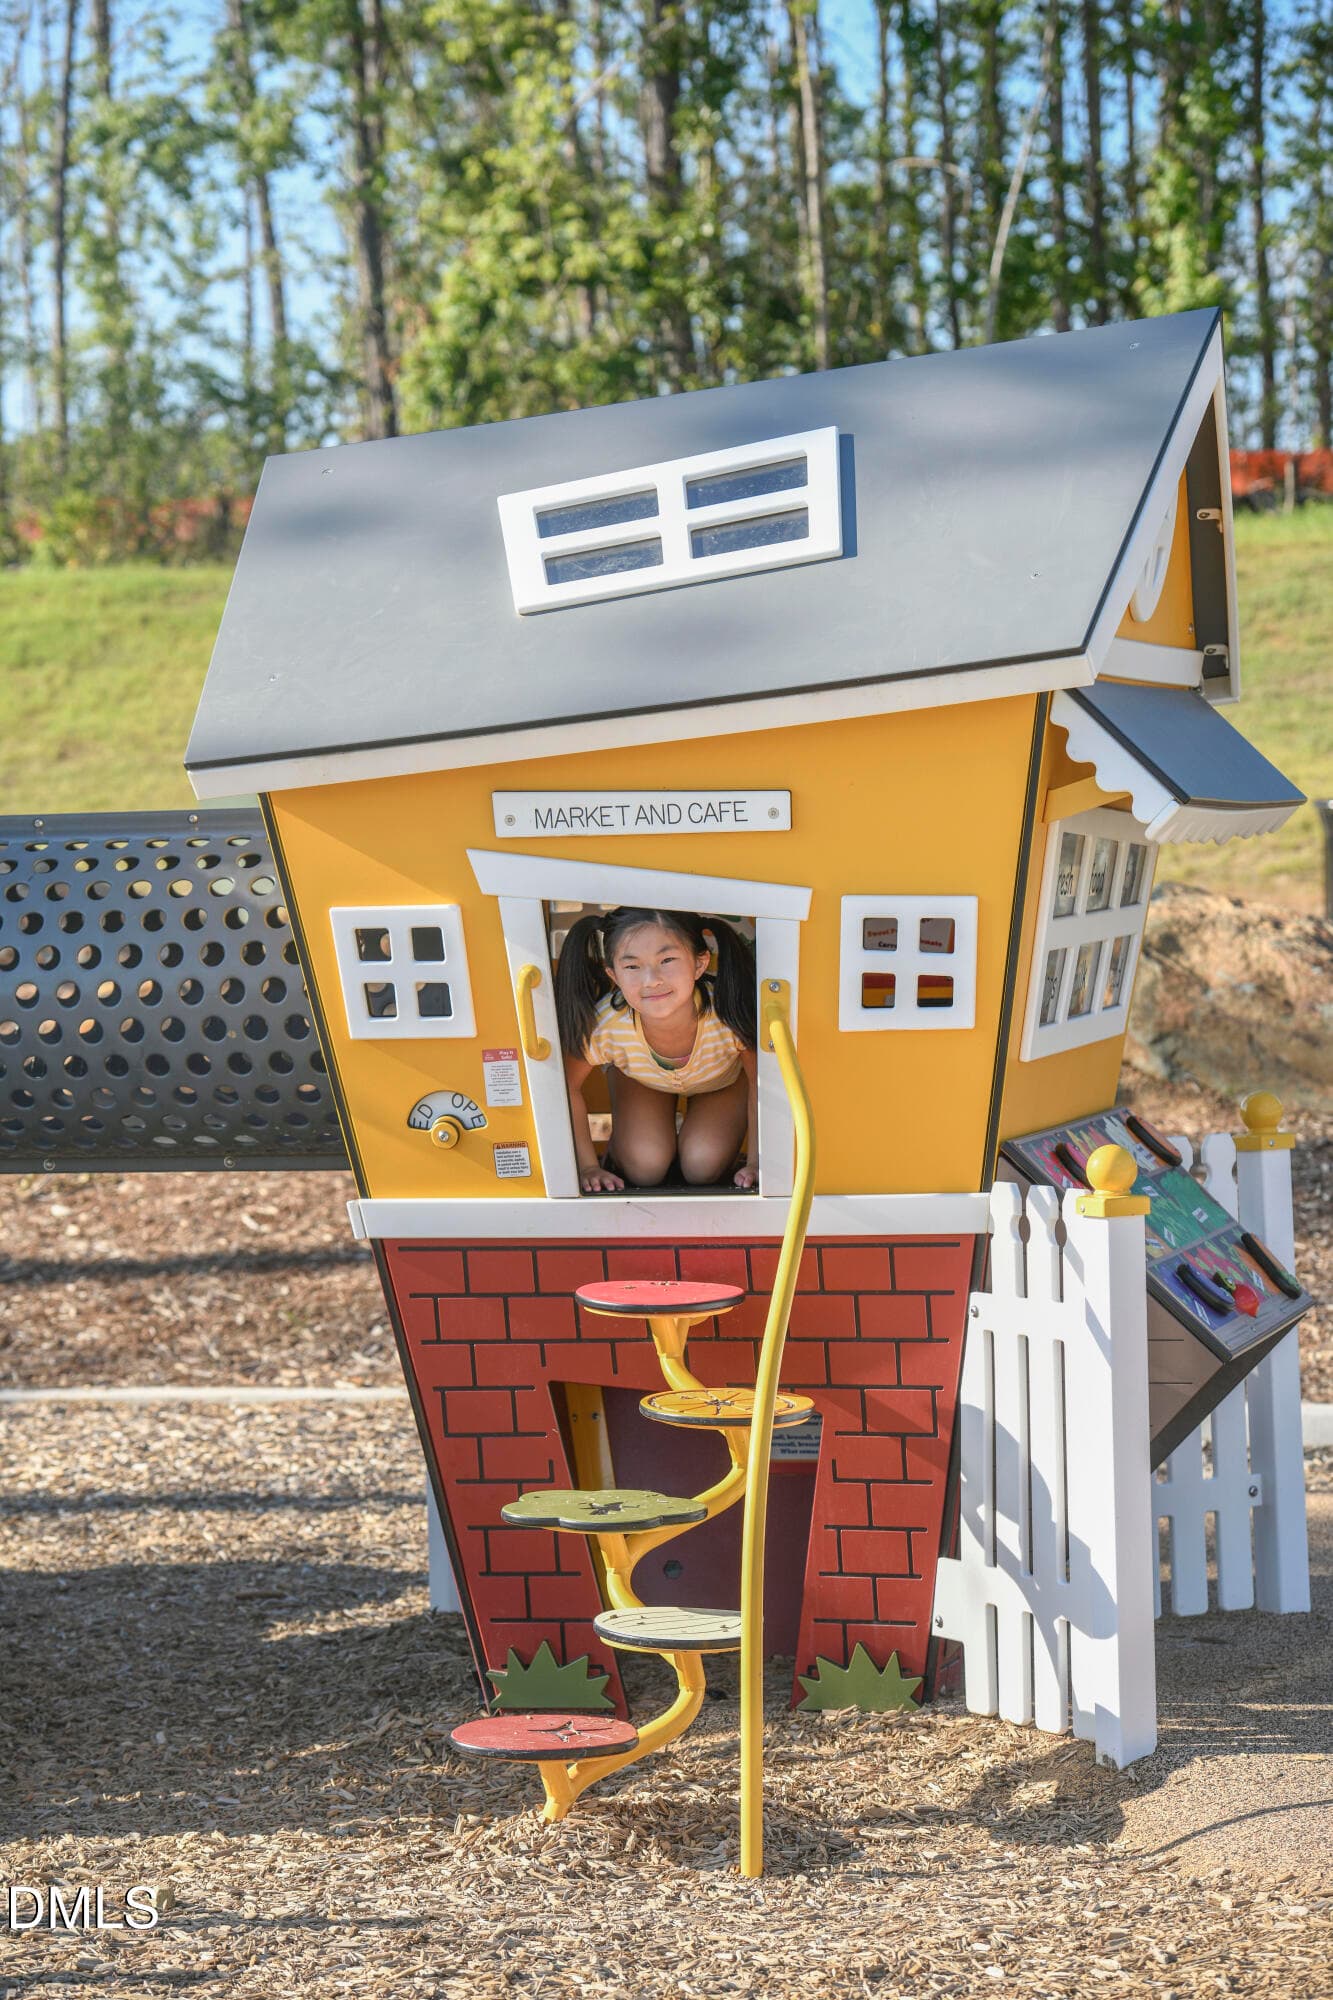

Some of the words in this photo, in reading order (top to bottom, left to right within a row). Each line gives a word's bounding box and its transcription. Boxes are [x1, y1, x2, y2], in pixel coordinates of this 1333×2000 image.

[534, 804, 630, 830] MARKET
[634, 803, 682, 826] AND
[687, 801, 749, 824] CAFE
[412, 1104, 433, 1129] ED
[451, 1092, 487, 1128] OPE
